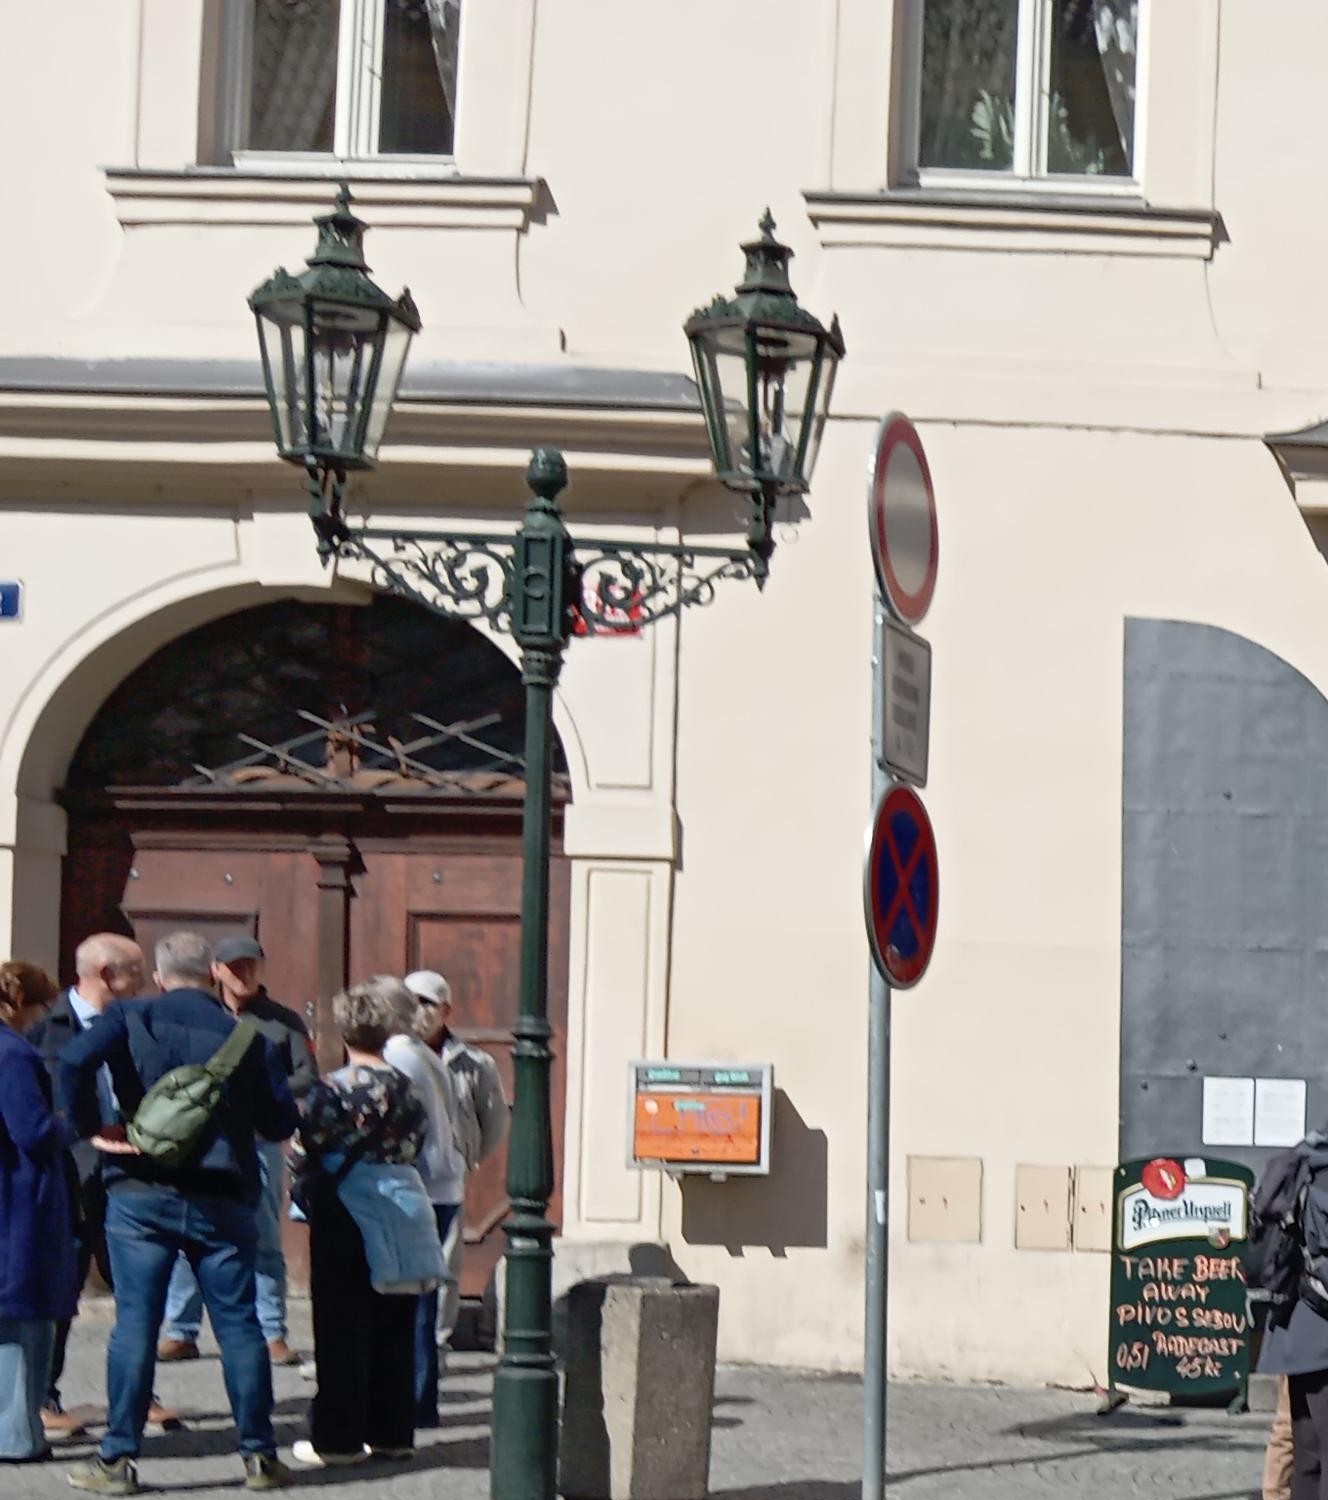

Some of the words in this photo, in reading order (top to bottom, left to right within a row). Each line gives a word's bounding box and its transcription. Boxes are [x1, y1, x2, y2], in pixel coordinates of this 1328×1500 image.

[1120, 1255, 1190, 1280] TAKE
[1192, 1254, 1247, 1286] BEER
[1142, 1282, 1210, 1304] AWAY
